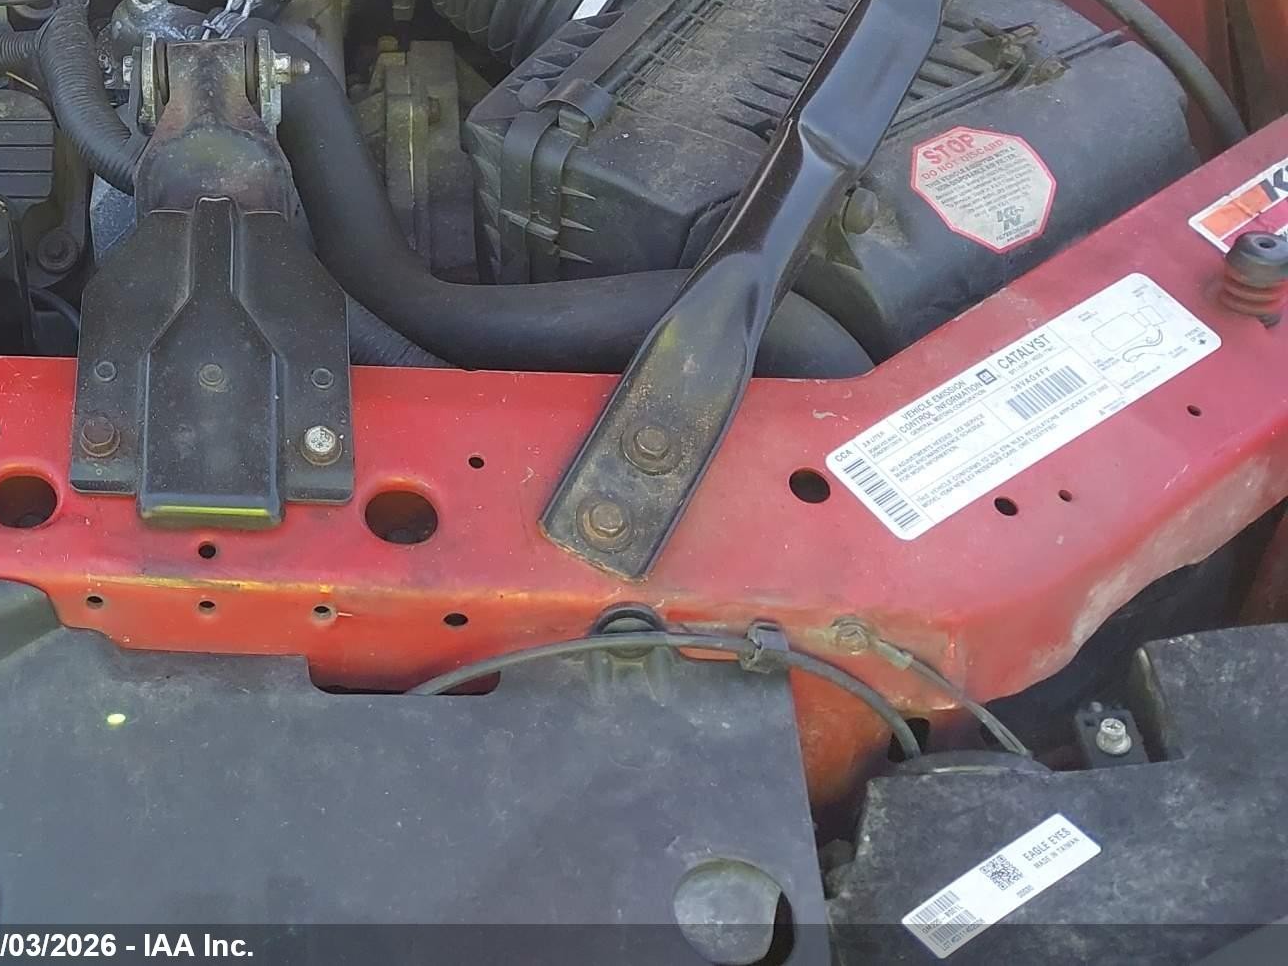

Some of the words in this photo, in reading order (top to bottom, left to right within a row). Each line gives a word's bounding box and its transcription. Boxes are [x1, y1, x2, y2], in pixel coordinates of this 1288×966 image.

[921, 168, 938, 180] DO
[939, 158, 957, 174] NOT
[961, 140, 1004, 162] DISCARD
[923, 133, 976, 165] STOP
[996, 333, 1051, 370] CATALYST
[898, 409, 935, 434] CONTROL
[934, 380, 983, 412] INFORMATION
[901, 399, 933, 420] VEHICLE
[931, 379, 966, 402] EMISSION
[910, 420, 933, 435] GENERAL
[932, 408, 953, 422] MOTORS
[834, 449, 853, 462] CCA
[1022, 842, 1050, 861] EAGLE
[1047, 827, 1072, 846] EYES
[1032, 858, 1052, 869] MADE
[1057, 837, 1081, 855] TAIWAN
